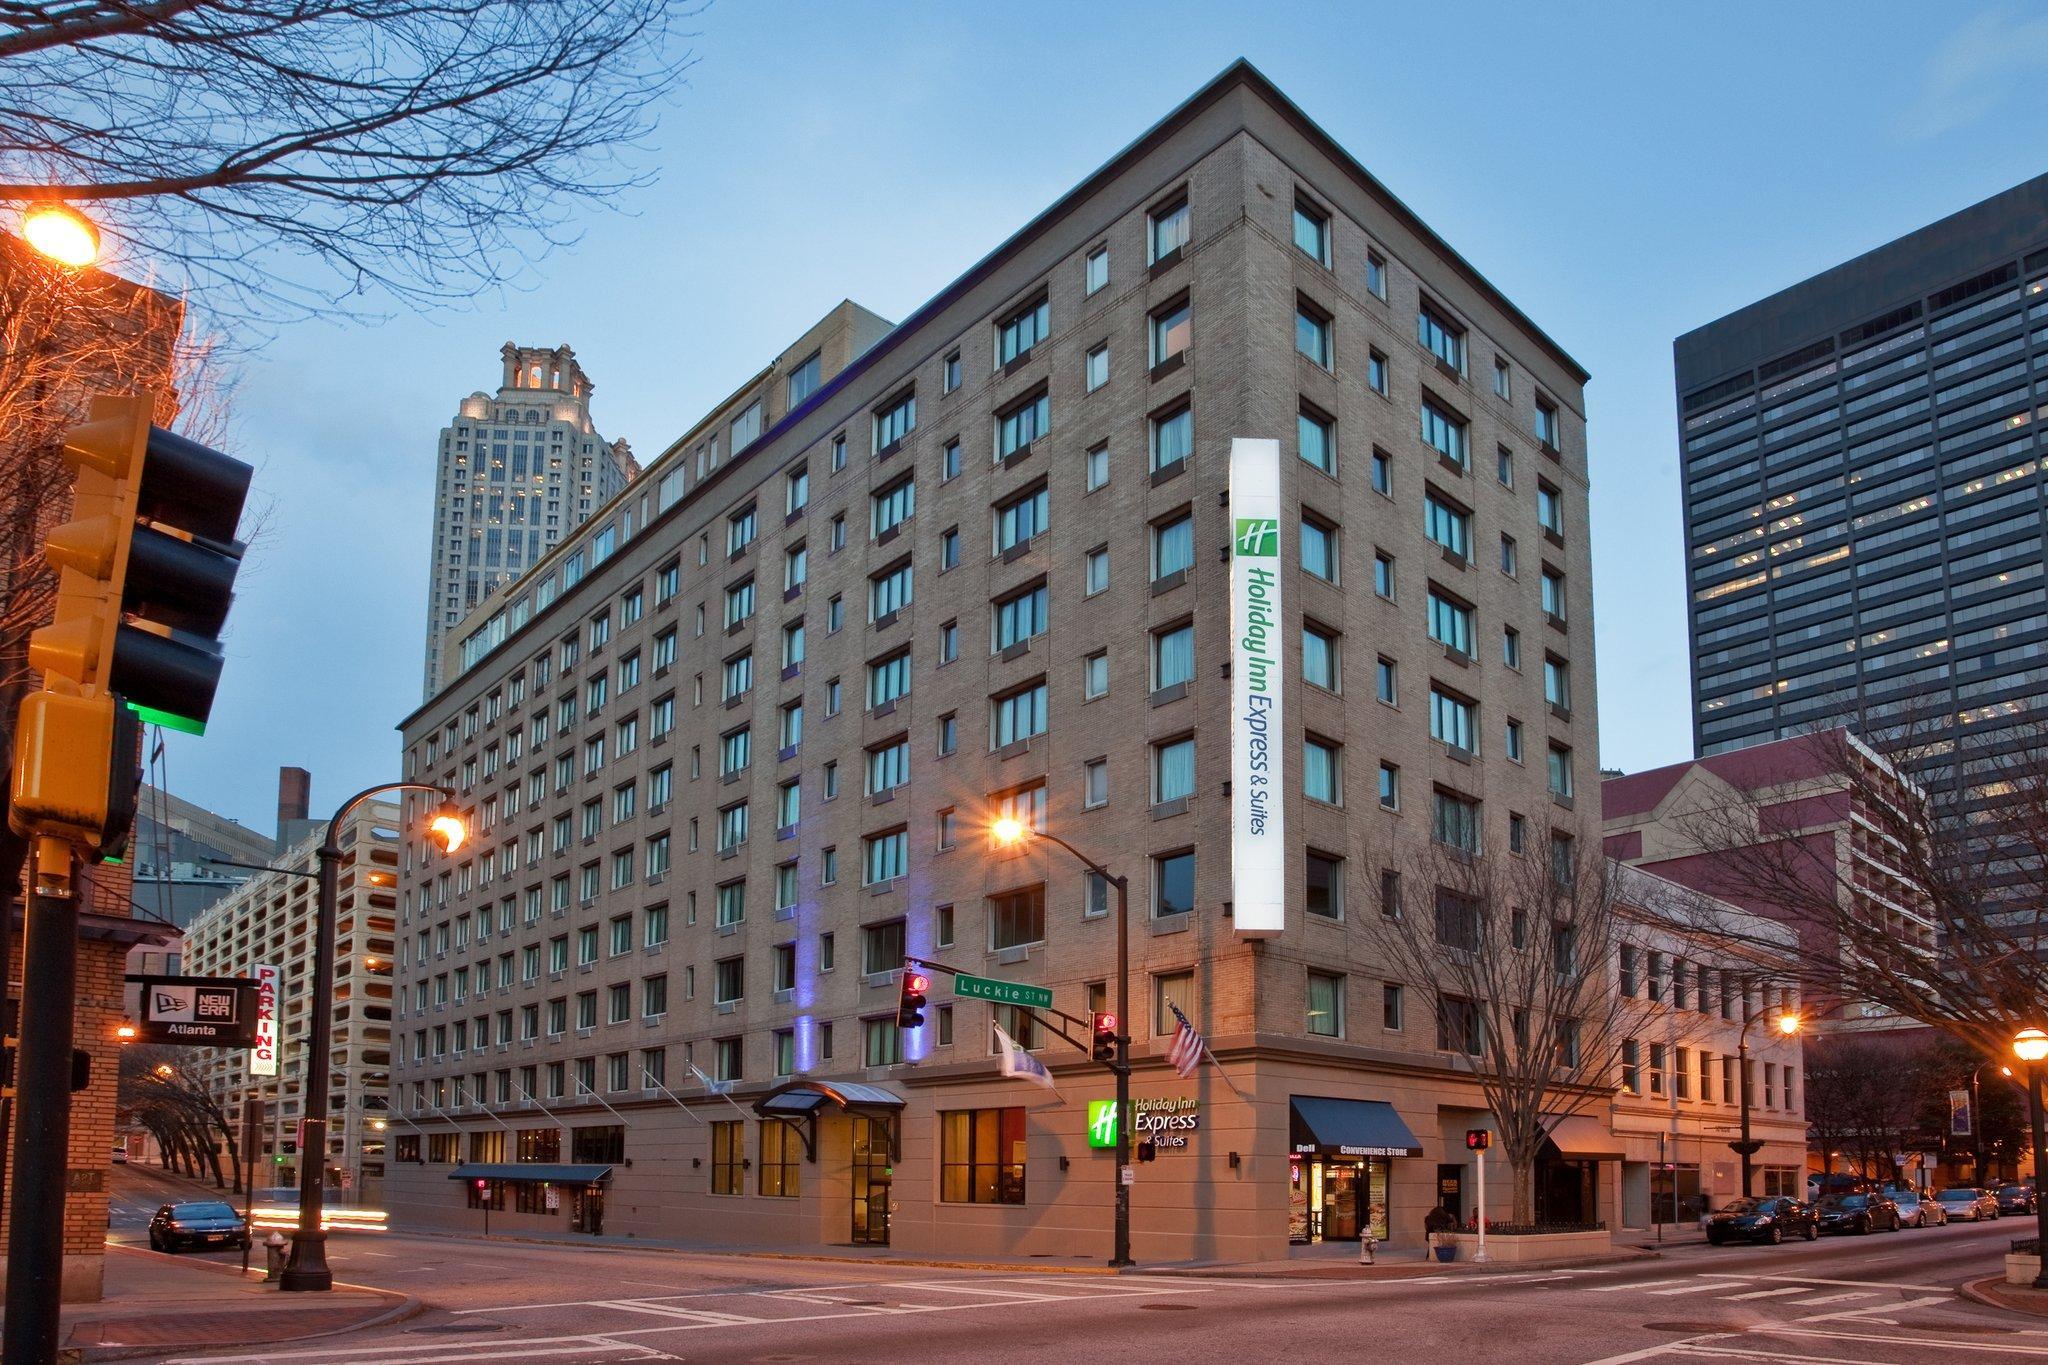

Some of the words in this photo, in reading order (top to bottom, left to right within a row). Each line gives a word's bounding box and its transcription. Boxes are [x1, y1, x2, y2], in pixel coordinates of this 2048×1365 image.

[1241, 567, 1275, 654] Holiday
[1248, 656, 1275, 692] Inn
[1243, 694, 1272, 772] Express
[1250, 774, 1268, 786] &
[1250, 789, 1268, 836] Suites
[198, 995, 230, 1006] NEW
[960, 980, 1020, 999] Luckie
[1024, 991, 1036, 1000] ST
[1038, 993, 1049, 1003] NW
[198, 1005, 230, 1016] ERA
[256, 968, 275, 1060] PARKING
[168, 1024, 216, 1036] Atlanta
[1135, 1099, 1177, 1113] Holiday
[1177, 1096, 1196, 1110] Inn
[1135, 1112, 1197, 1135] Express
[1154, 1135, 1185, 1147] Suites
[1340, 1145, 1386, 1156] CONVENIENCE
[1386, 1147, 1408, 1157] STORE
